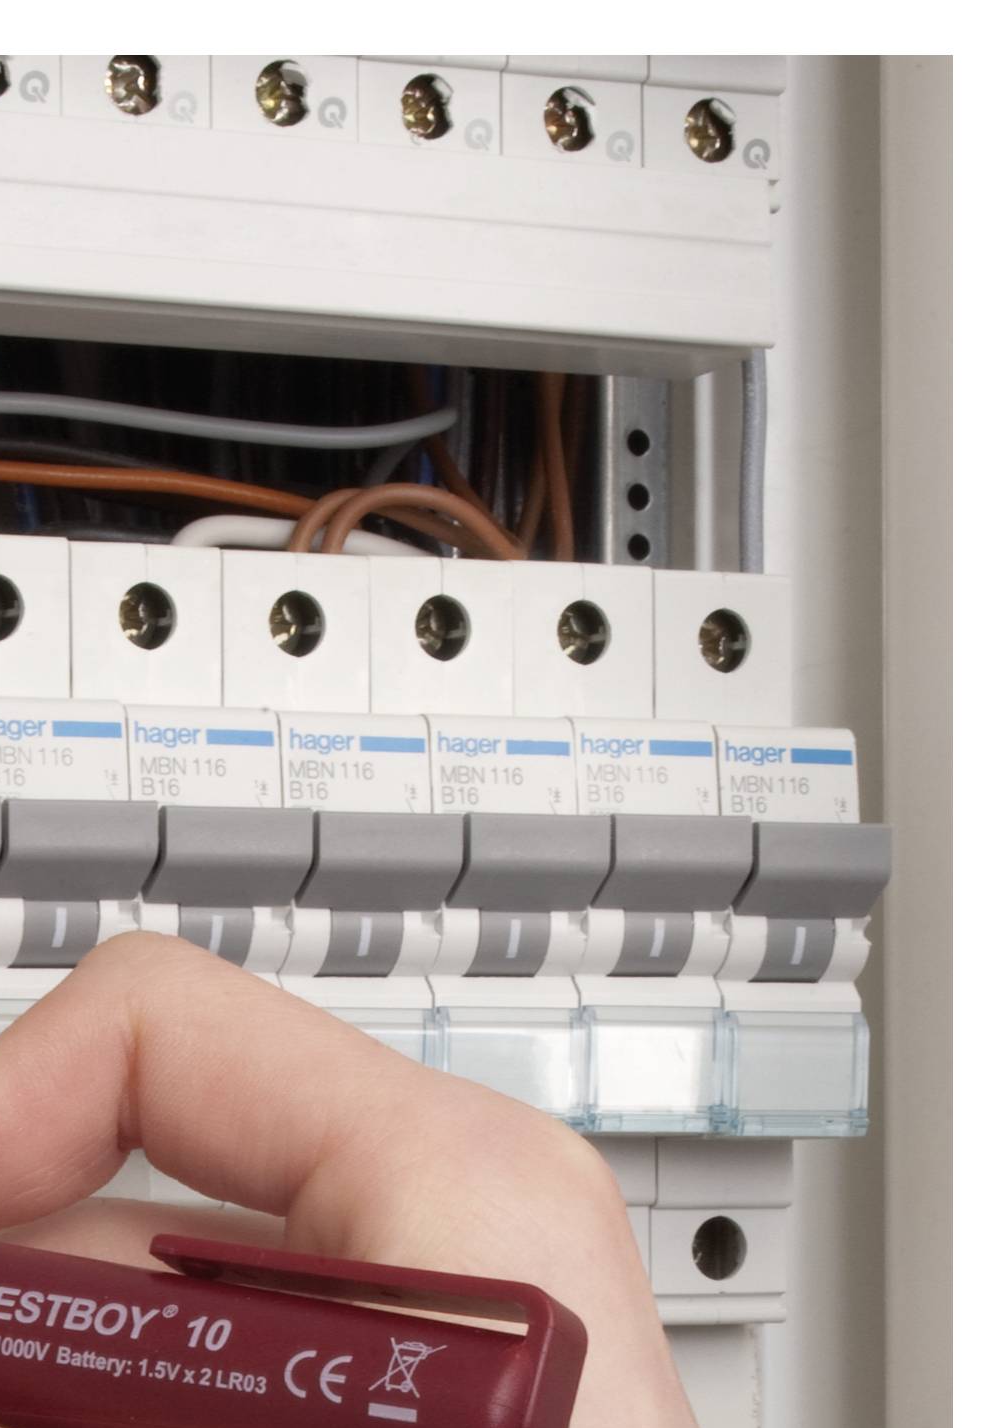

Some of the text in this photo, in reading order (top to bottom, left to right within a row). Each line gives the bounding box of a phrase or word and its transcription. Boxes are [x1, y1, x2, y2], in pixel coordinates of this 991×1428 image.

[134, 721, 201, 748] hager
[289, 728, 355, 754] hager
[438, 731, 500, 758] hager
[581, 733, 644, 758] hager
[725, 740, 786, 766] hager
[41, 748, 73, 767] 116
[140, 757, 226, 778] MBN 116
[289, 761, 374, 781] MBN 116
[440, 765, 523, 785] MBN 116
[587, 764, 669, 784] MBN 116
[142, 778, 180, 797] B16
[289, 781, 328, 800] B16
[442, 786, 480, 805] B16
[588, 785, 624, 804] B16
[730, 775, 809, 796] MBN 116
[731, 795, 767, 814] B16
[186, 1315, 232, 1352] 10
[56, 1346, 133, 1378] Battery:
[138, 1358, 181, 1382] 1.5V
[182, 1368, 195, 1385] x
[199, 1368, 212, 1386] 2
[215, 1370, 267, 1394] LR03
